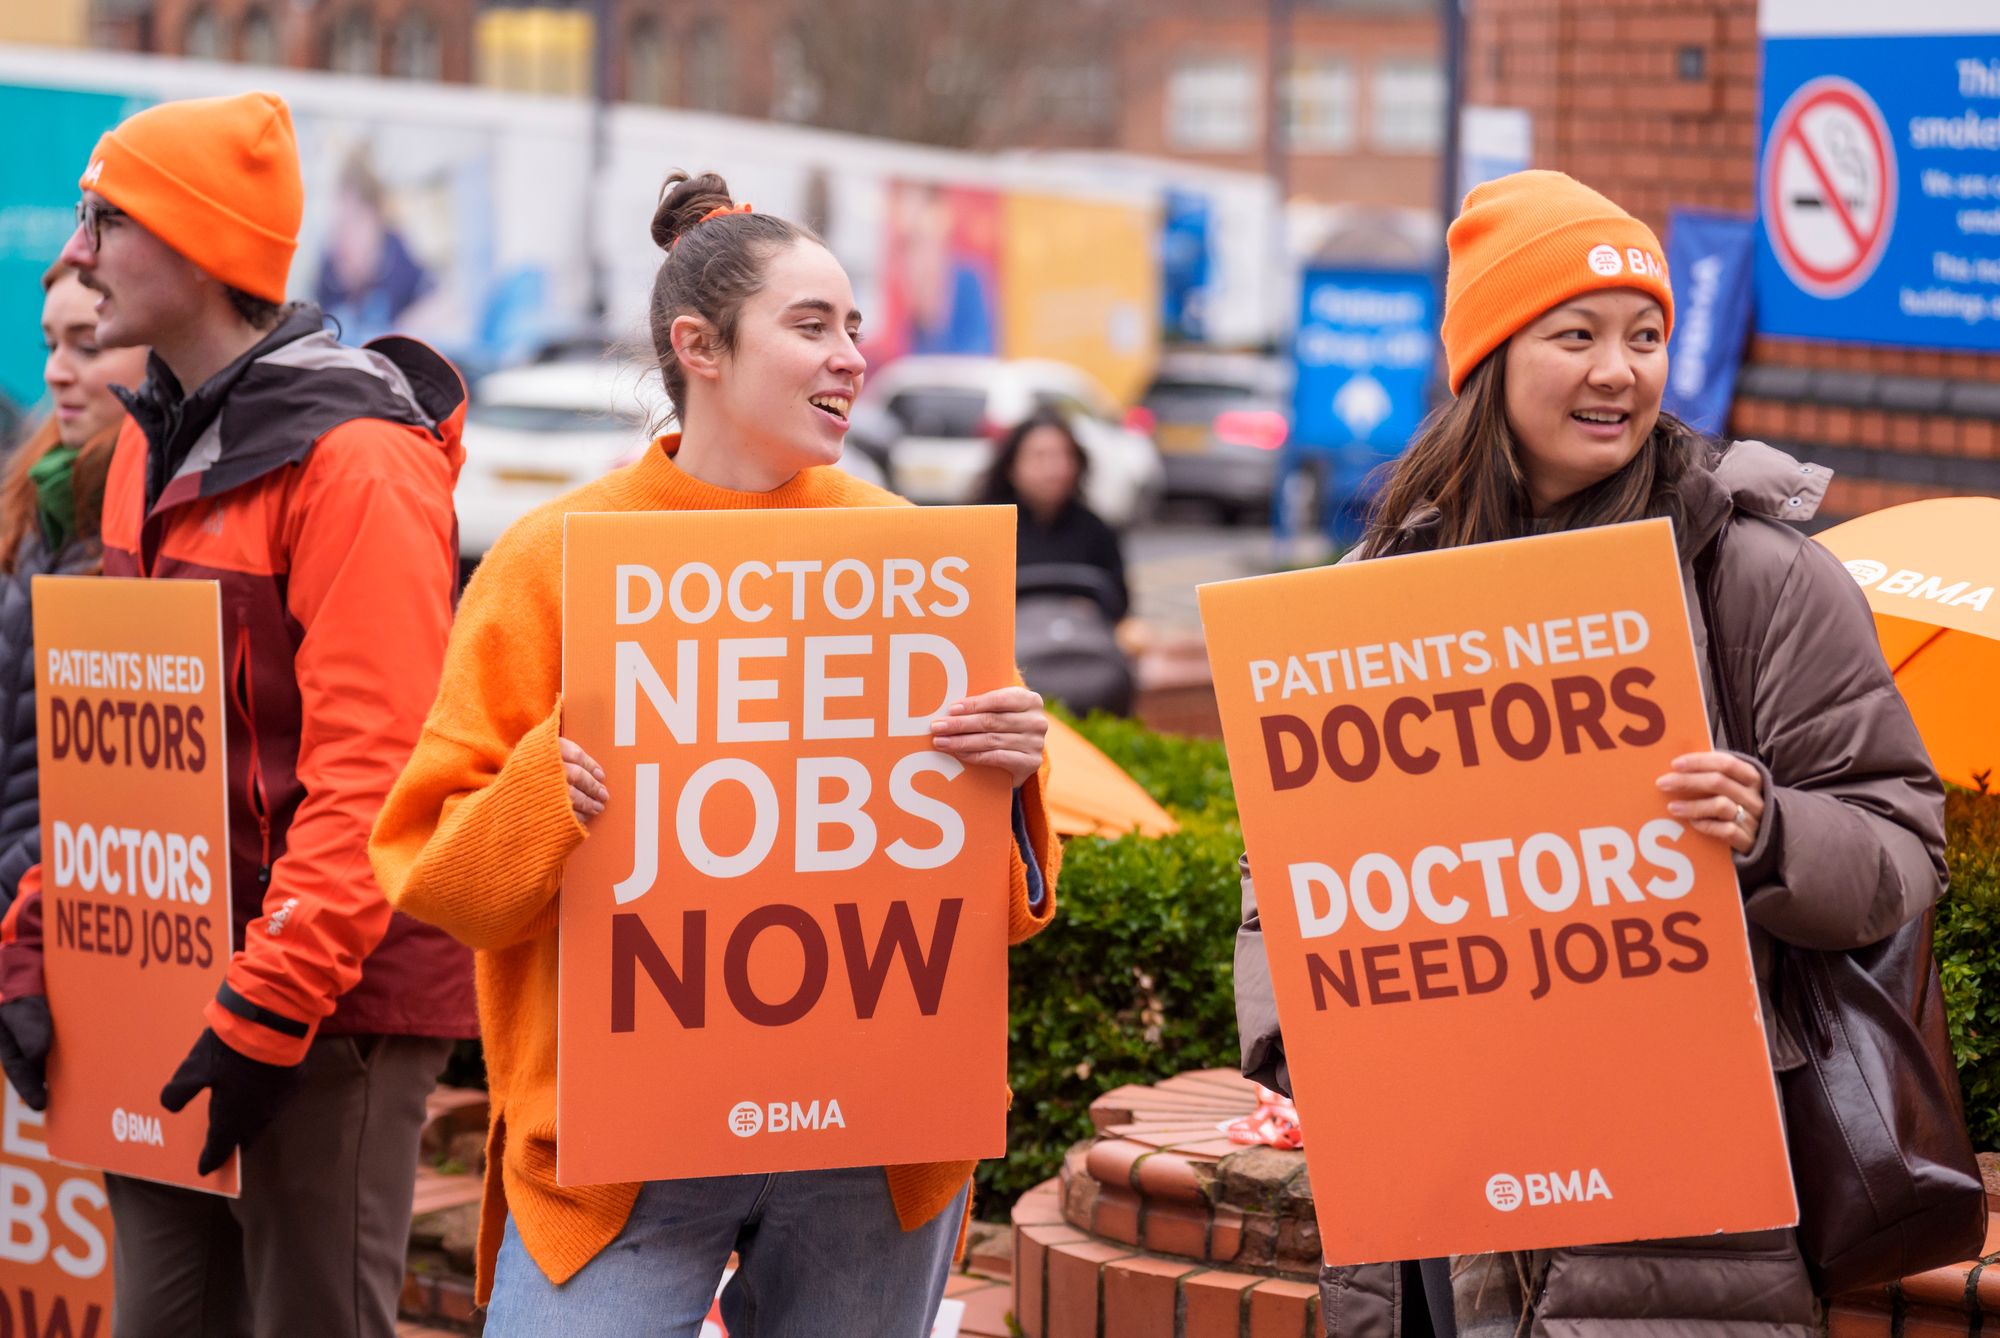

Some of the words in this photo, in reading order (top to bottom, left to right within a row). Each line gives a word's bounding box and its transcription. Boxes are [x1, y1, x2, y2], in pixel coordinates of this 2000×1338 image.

[615, 556, 970, 625] DOCTORS
[1876, 569, 1995, 612] BMA
[48, 648, 142, 691] PATIENTS
[147, 655, 205, 694] NEED
[614, 634, 968, 747] NEED
[1249, 630, 1492, 703] PATIENTS
[1503, 610, 1650, 669] NEED
[50, 696, 207, 773] DOCTORS
[1260, 666, 1666, 792] DOCTORS
[53, 820, 212, 906] DOCTORS
[613, 751, 966, 905] JOBS
[1288, 819, 1695, 939] DOCTORS
[57, 898, 133, 956] NEED
[140, 909, 213, 969] JOBS
[611, 898, 964, 1033] NOW
[1305, 934, 1508, 1012] NEED
[1529, 911, 1710, 1001] JOBS
[128, 1114, 164, 1147] BMA
[767, 1099, 846, 1133] BMA
[1525, 1168, 1613, 1206] BMA
